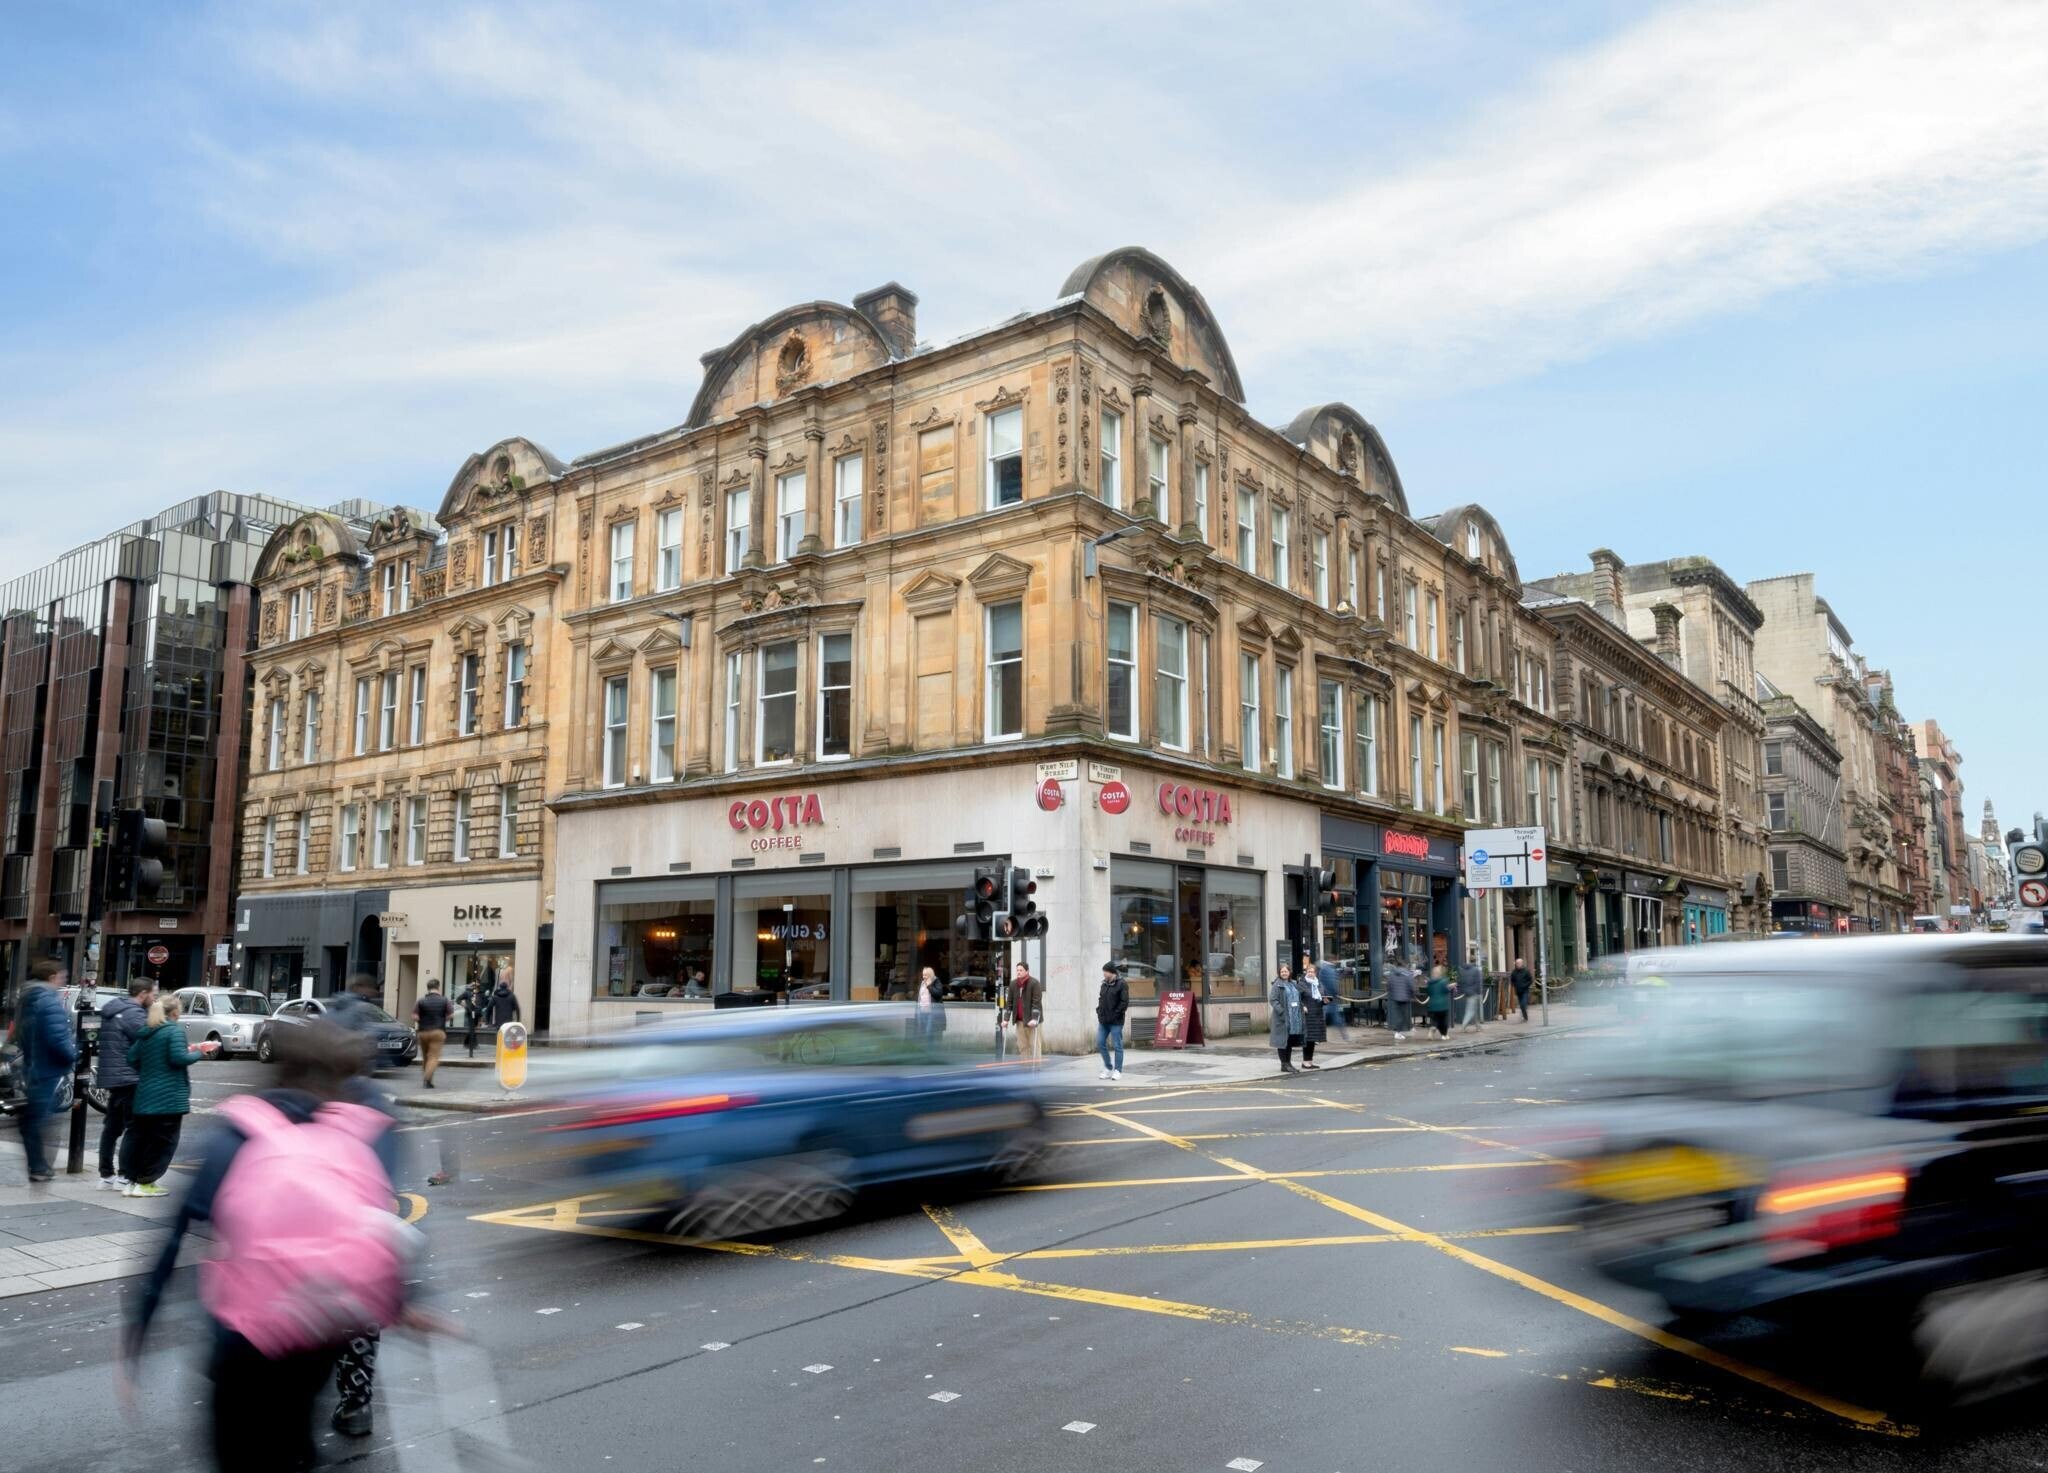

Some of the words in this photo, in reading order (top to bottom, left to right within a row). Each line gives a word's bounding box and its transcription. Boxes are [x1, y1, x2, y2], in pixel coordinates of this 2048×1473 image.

[1039, 763, 1057, 771] WEST
[1059, 761, 1074, 769] NILE
[1099, 766, 1119, 775] VINCENT
[1044, 769, 1069, 777] STREET
[1096, 771, 1114, 780] STREET
[1043, 788, 1060, 798] COSTA
[1101, 791, 1126, 800] COSTA
[1158, 782, 1233, 824] COSTA
[728, 793, 825, 832] COSTA
[1174, 828, 1216, 846] COFFEE
[1516, 833, 1535, 841] traffic
[750, 835, 803, 852] COFFEE
[453, 904, 503, 921] blitz
